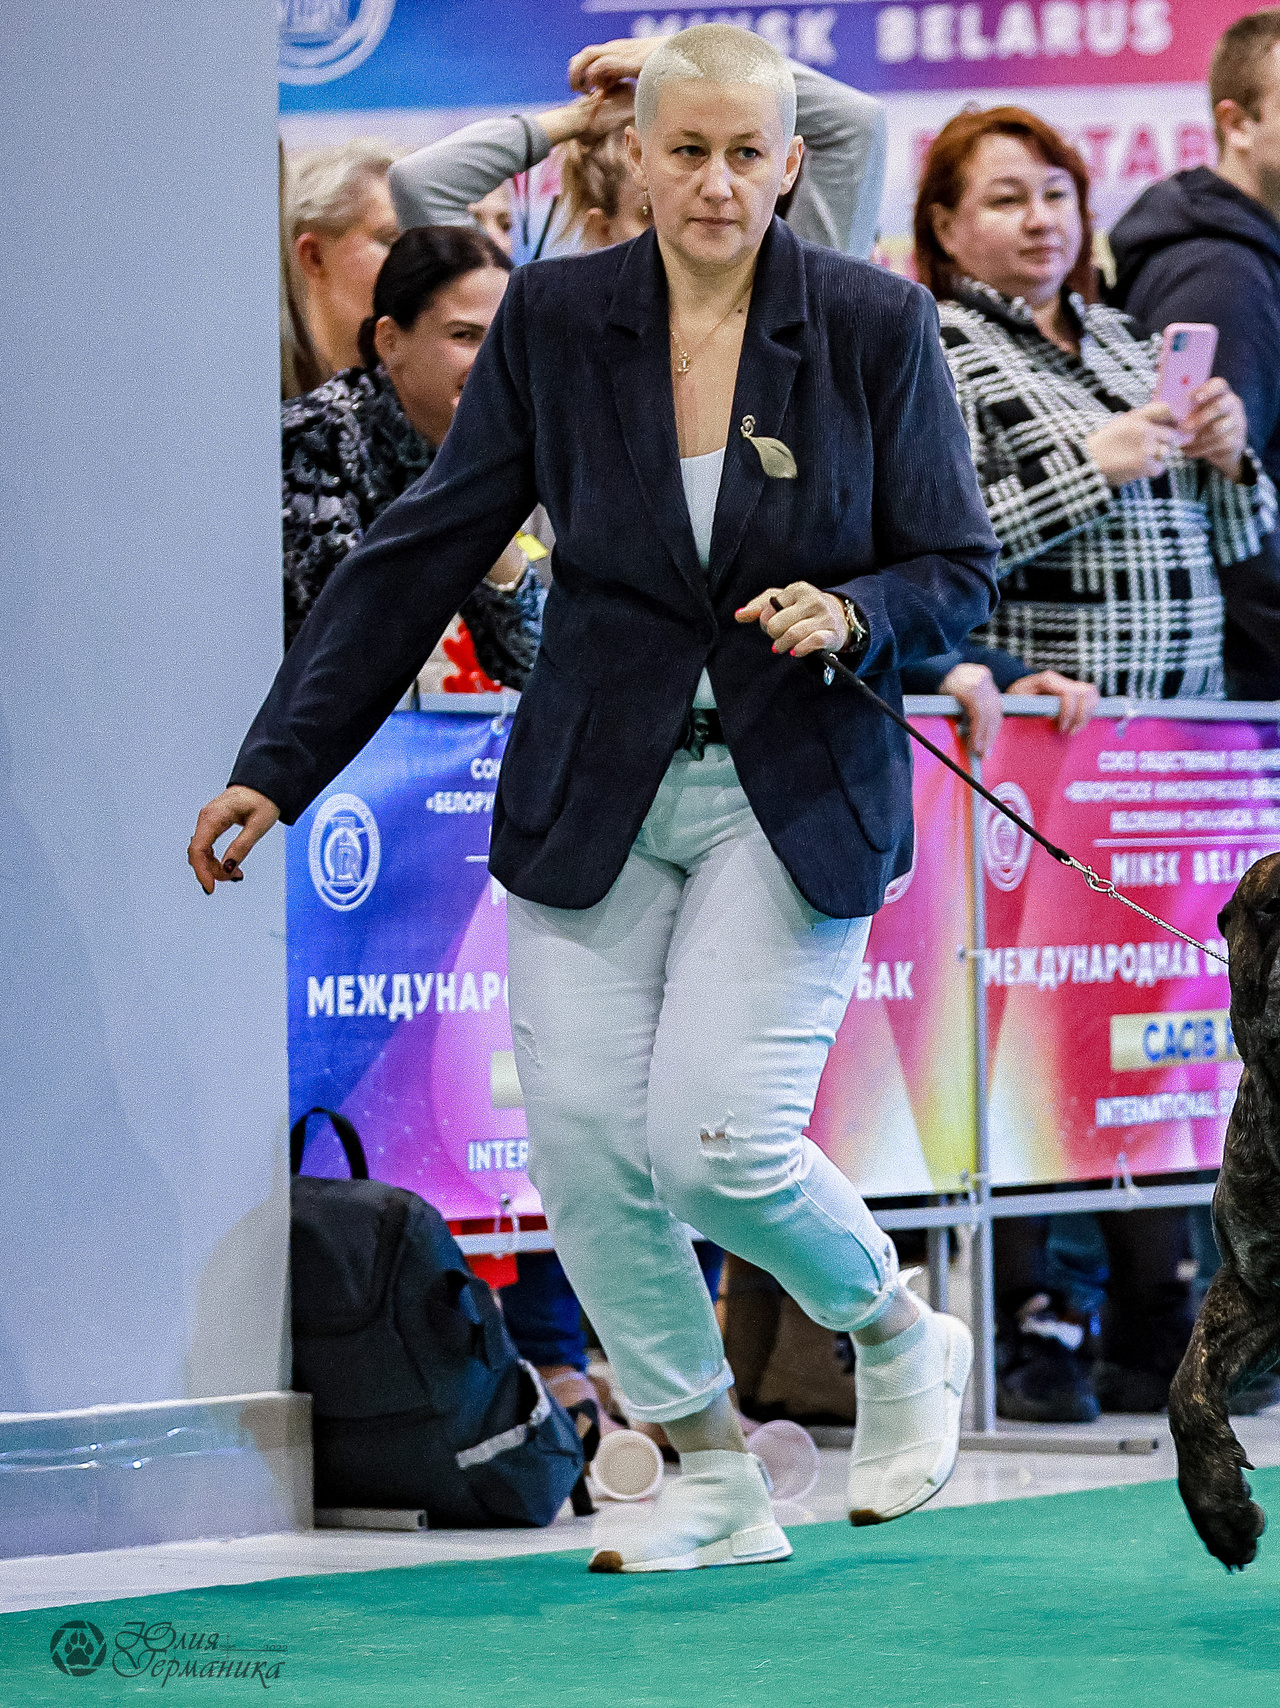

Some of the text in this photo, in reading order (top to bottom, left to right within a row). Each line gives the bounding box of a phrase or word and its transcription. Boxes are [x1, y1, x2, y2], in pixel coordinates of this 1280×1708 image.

[875, 0, 1173, 64] BELARUS
[983, 940, 1201, 991] МЕЖДУНАРОДНАЯ
[306, 971, 510, 1022] МЕЖДУНАР
[1143, 1018, 1217, 1063] CACIB
